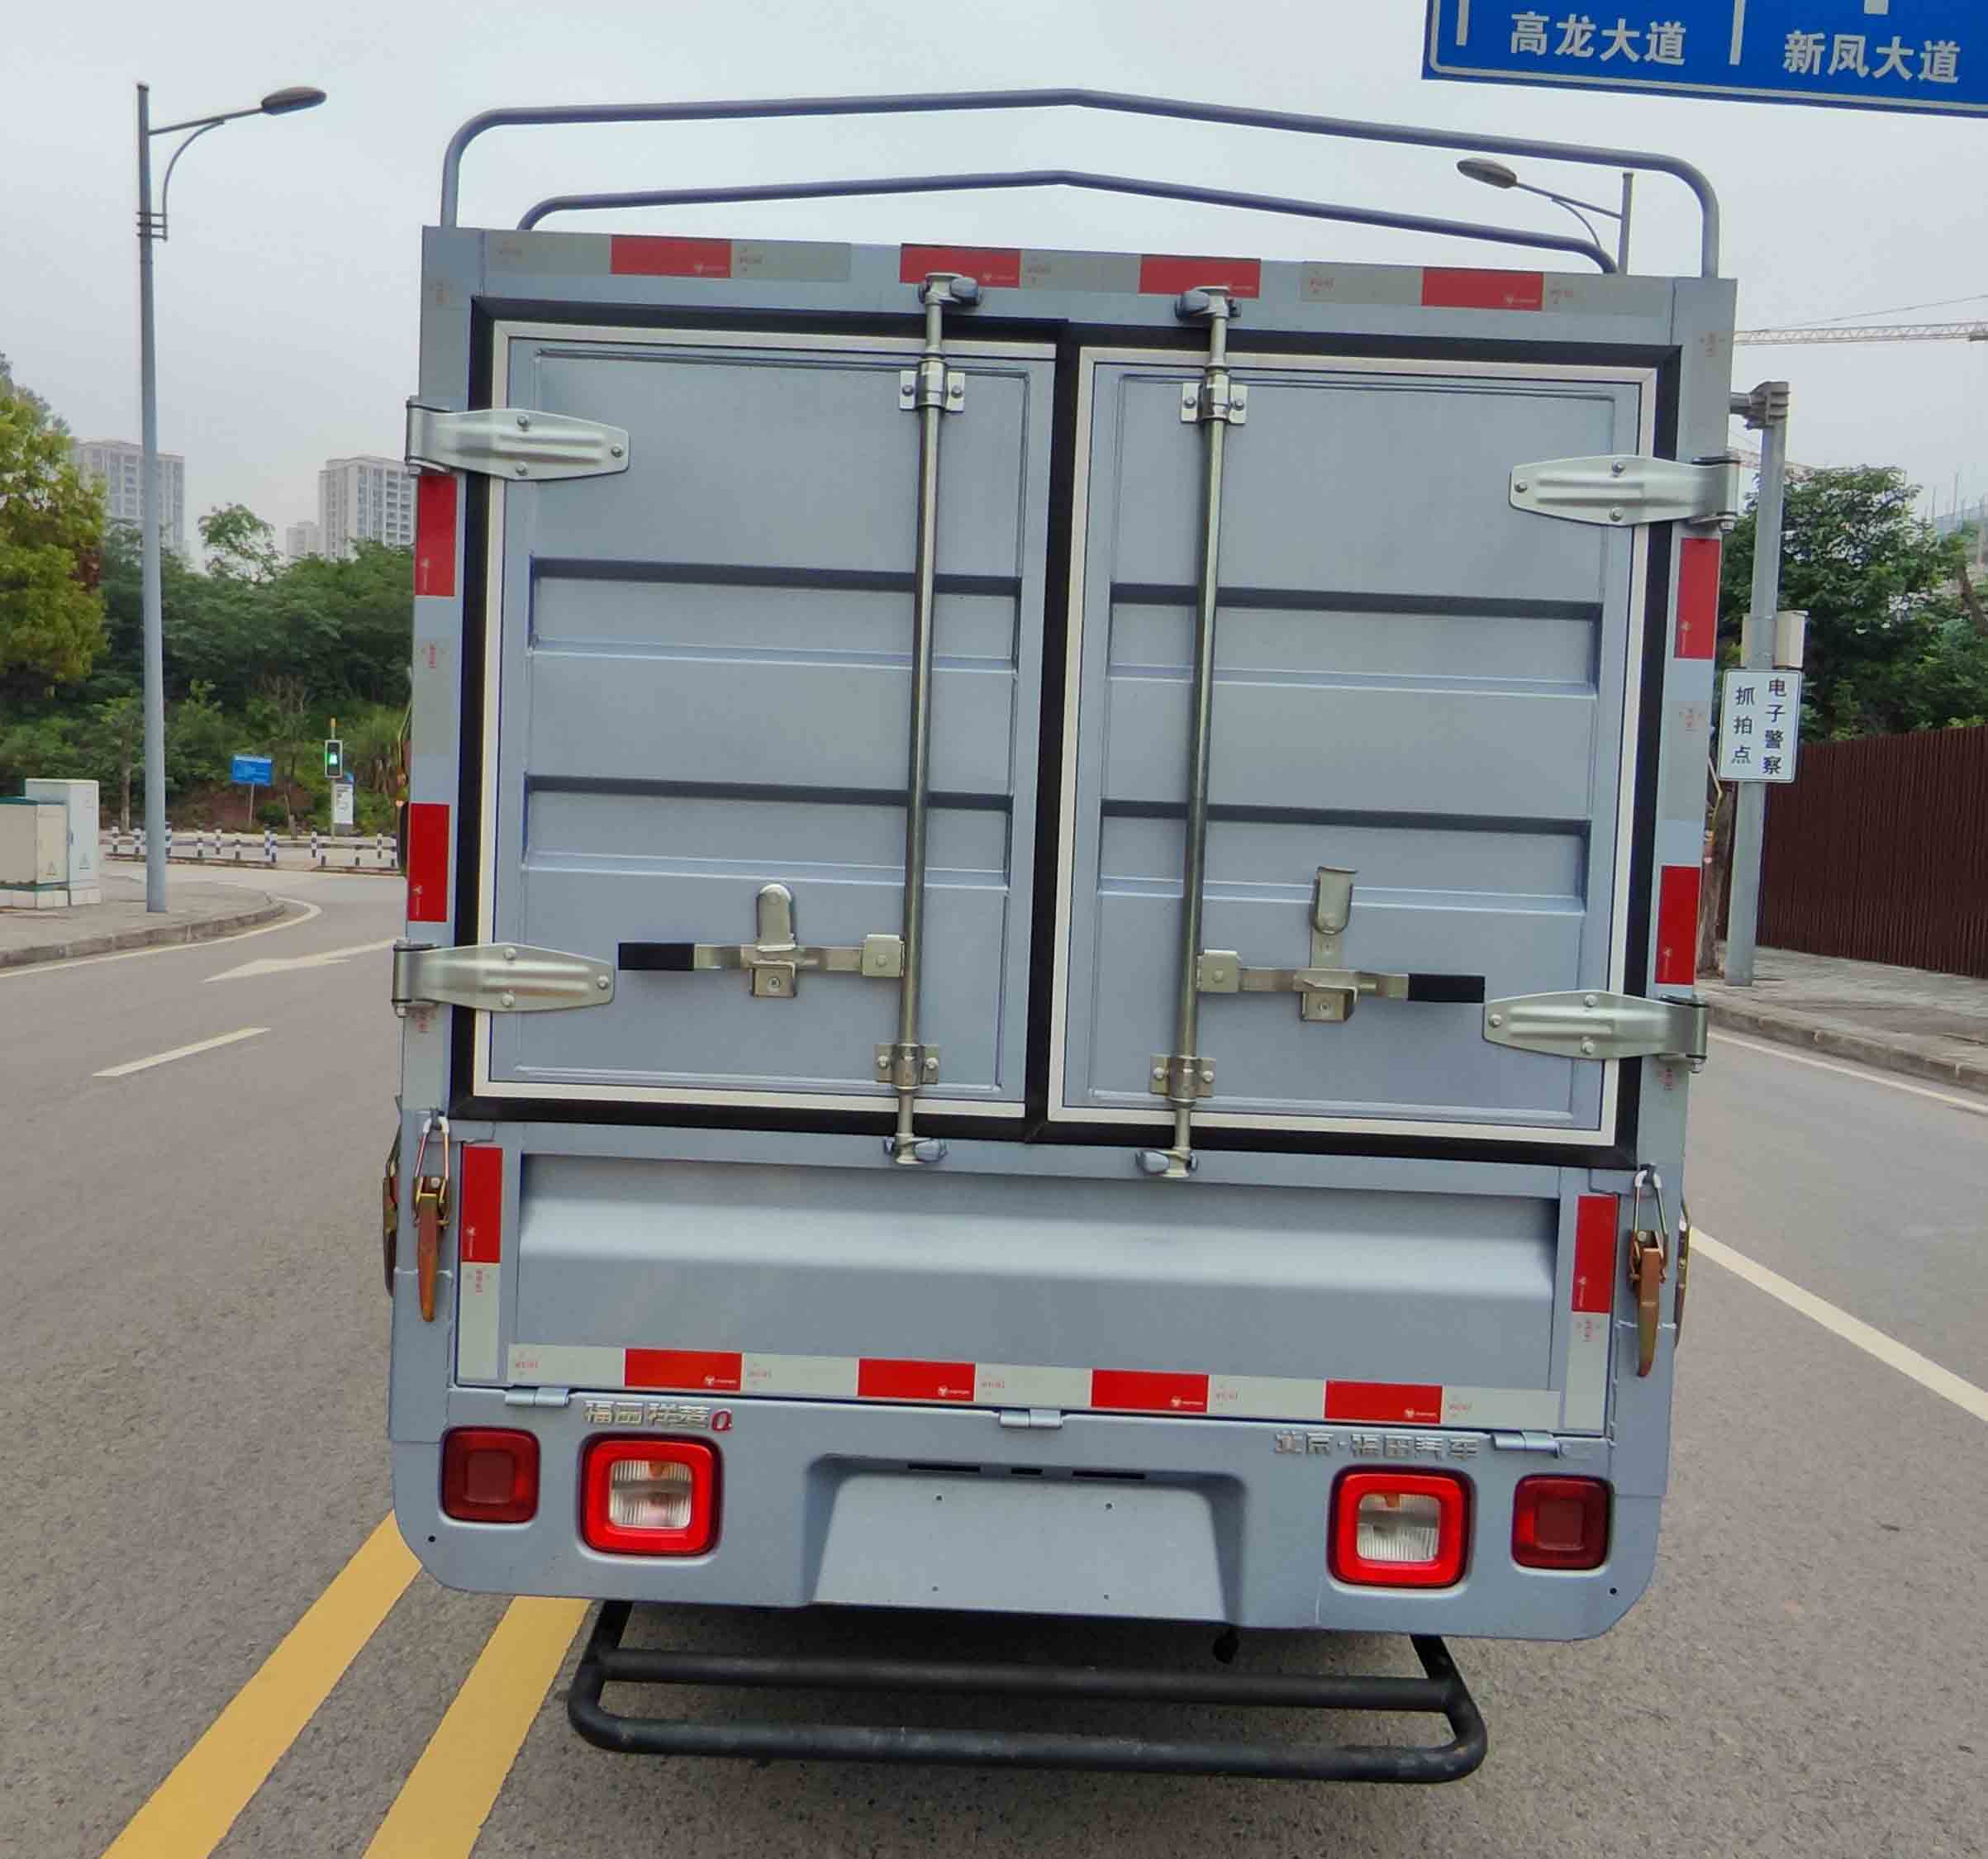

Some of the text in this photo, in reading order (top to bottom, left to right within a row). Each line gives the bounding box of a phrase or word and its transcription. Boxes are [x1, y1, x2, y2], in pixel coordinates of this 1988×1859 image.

[1510, 11, 1686, 65] 高龙大道
[1784, 30, 1962, 83] 新凤大道
[1732, 687, 1756, 764] 抓拍点
[1762, 678, 1786, 774] 电子警察
